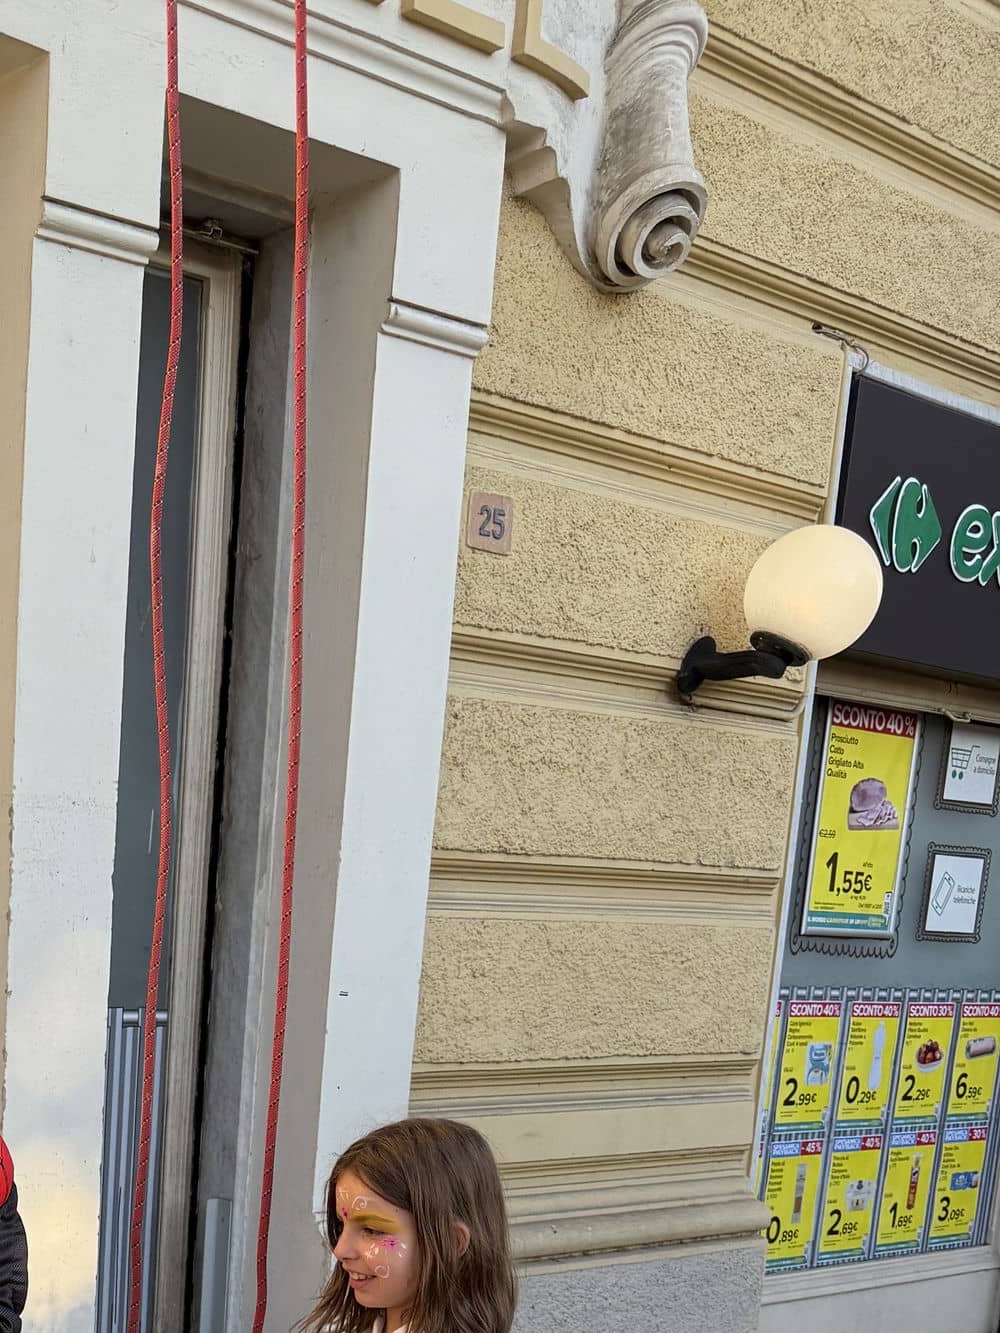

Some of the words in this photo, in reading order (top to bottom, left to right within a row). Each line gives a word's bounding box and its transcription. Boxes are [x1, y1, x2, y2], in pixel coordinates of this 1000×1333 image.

[479, 505, 505, 540] 25
[832, 704, 886, 731] SCONTO
[831, 733, 859, 745] Prosciutto
[829, 745, 844, 755] Cotto
[853, 760, 864, 769] Alta
[826, 851, 872, 896] 1,55€
[791, 1004, 823, 1016] SCONTO
[853, 1004, 883, 1016] SCONTO
[910, 1005, 938, 1016] SCONTO
[963, 1005, 990, 1016] SCONTO
[783, 1078, 817, 1107] 2,99€
[846, 1076, 877, 1104] 0,29€
